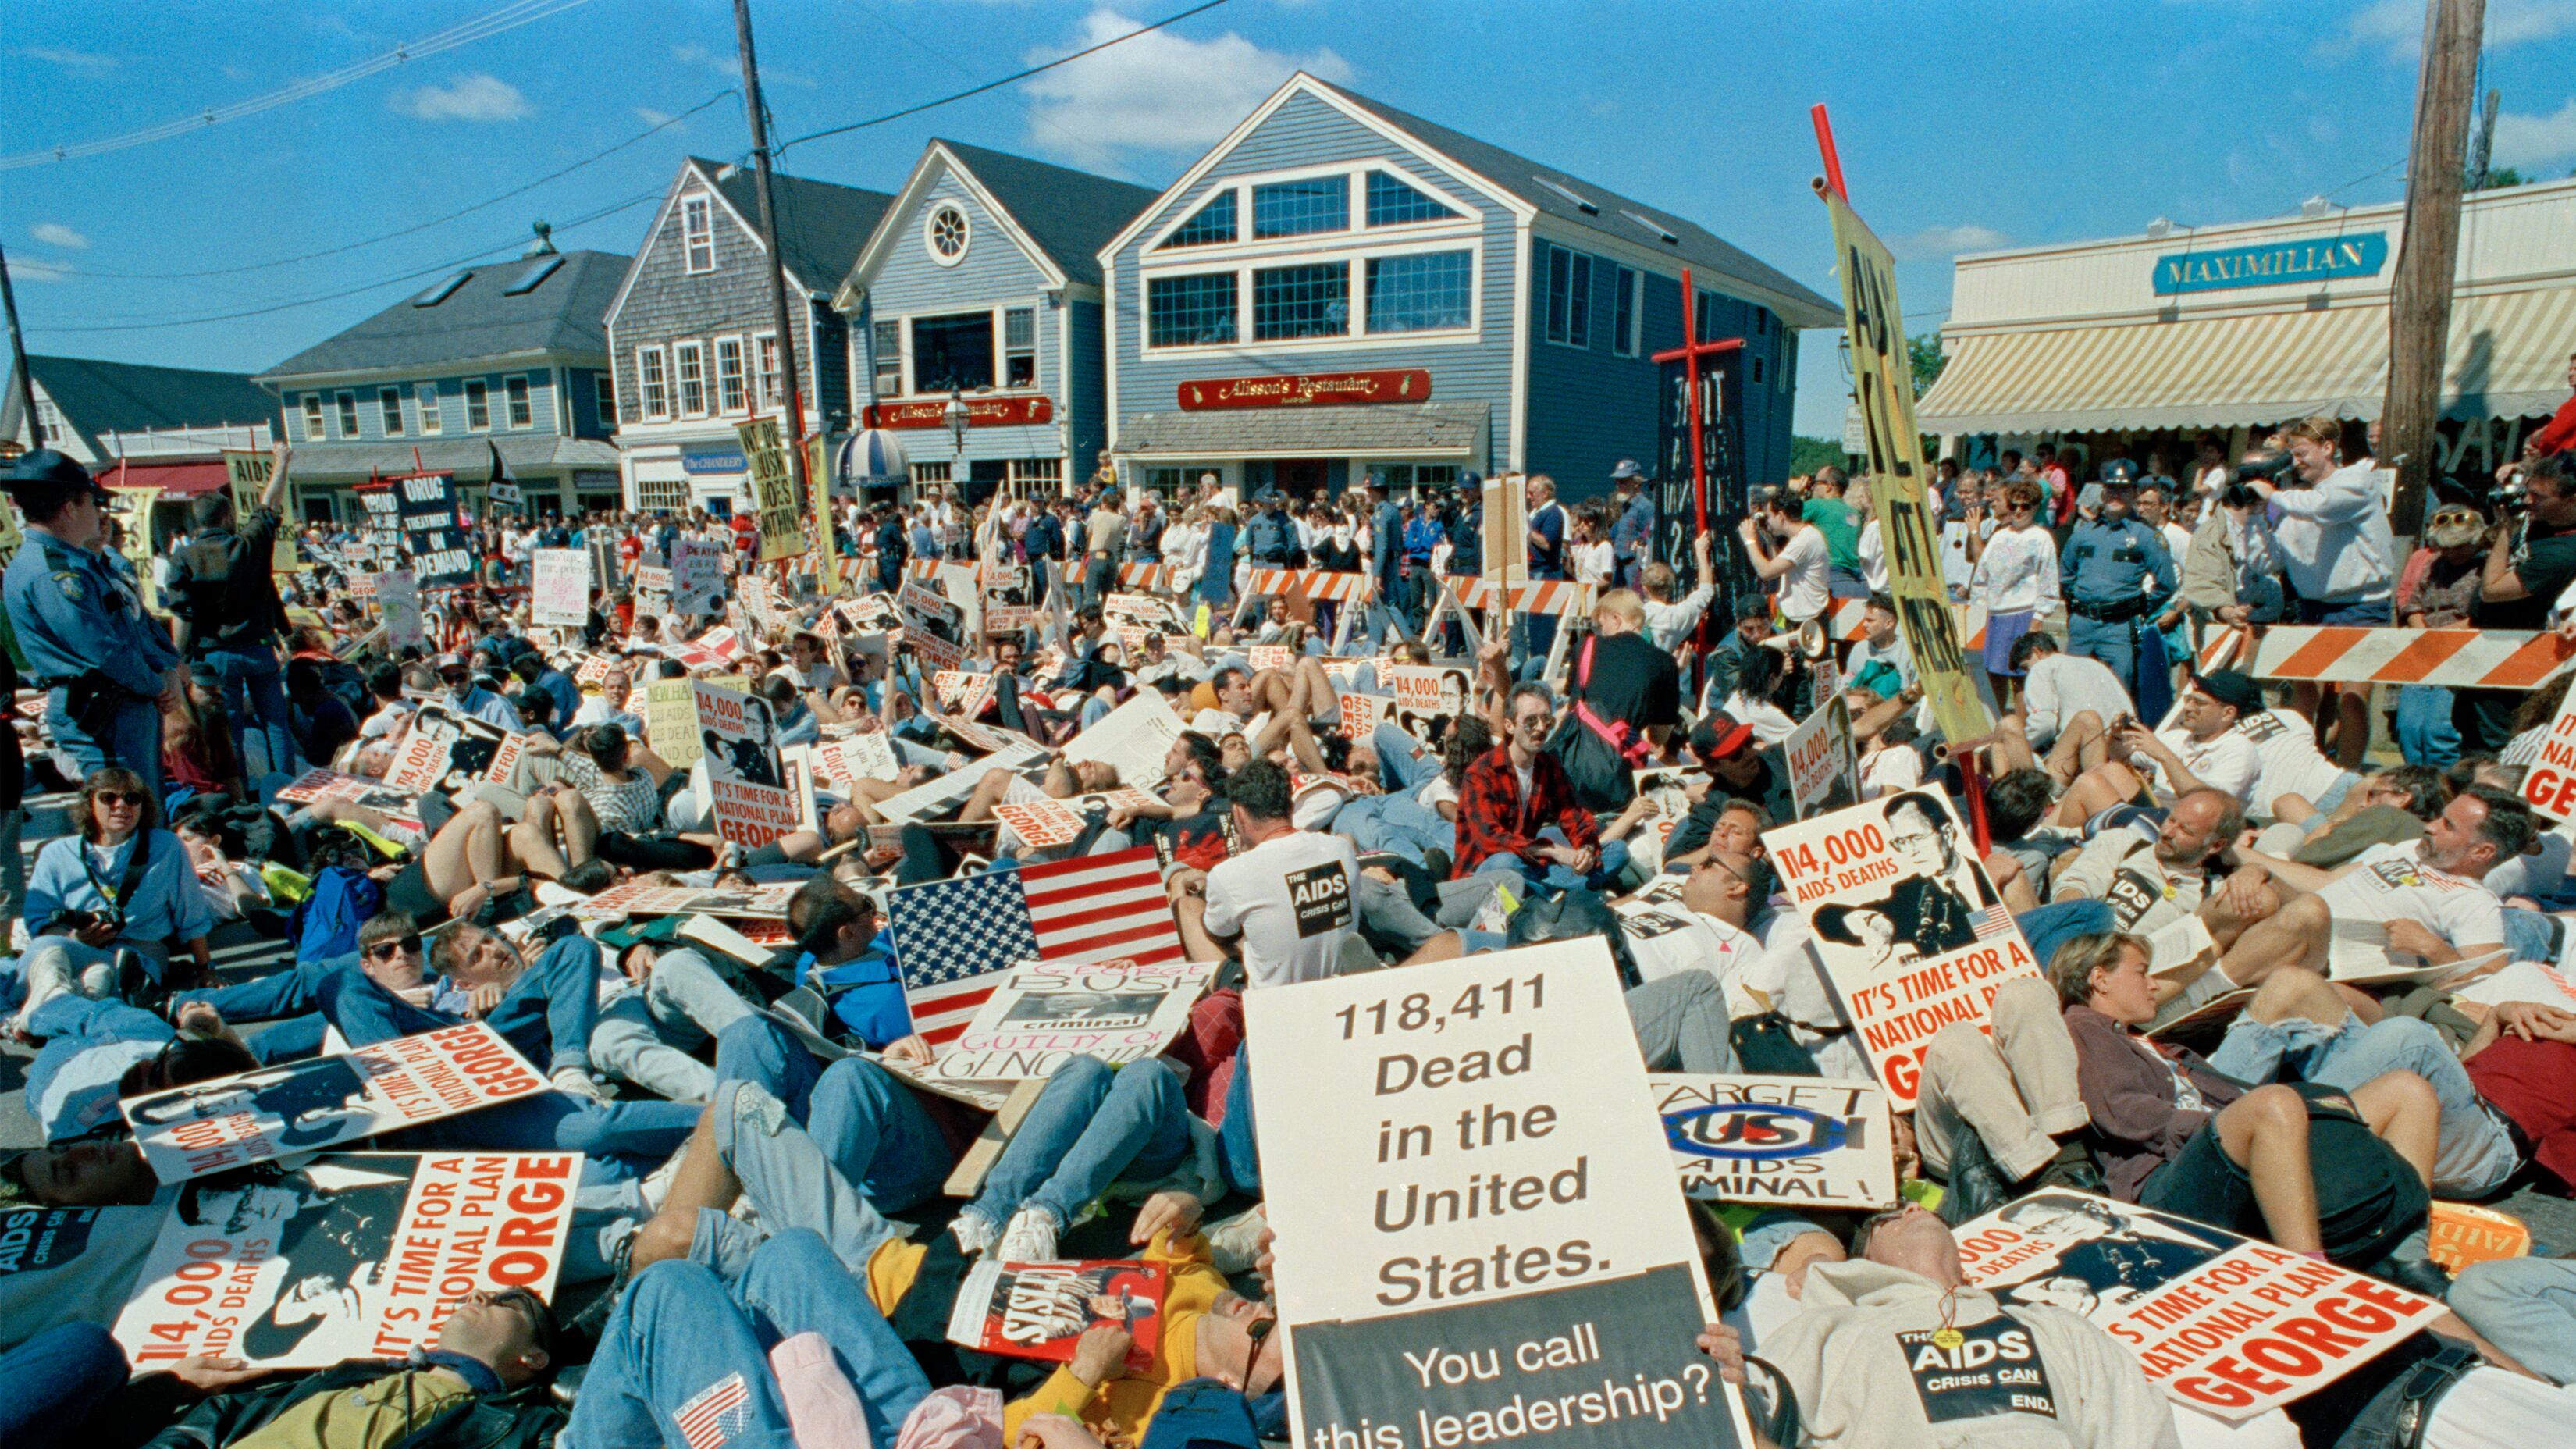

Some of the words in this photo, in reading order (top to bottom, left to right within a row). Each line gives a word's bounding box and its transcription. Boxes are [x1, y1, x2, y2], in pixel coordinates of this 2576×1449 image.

[2169, 241, 2366, 283] MAXIMILIAN
[1220, 378, 1290, 399] Alisson's
[1297, 376, 1379, 397] Restaurant
[891, 404, 942, 422] Alisson's
[699, 456, 744, 468] CHANDLERY
[404, 476, 446, 502] DRUG
[404, 512, 453, 532] TREATMENT
[430, 532, 446, 550] ON
[686, 546, 720, 557] DEATH
[413, 549, 471, 578] DEMAND
[352, 587, 375, 596] GEOR
[1396, 678, 1438, 696] 114,000
[667, 707, 692, 721] AIDS
[1342, 695, 1354, 739] GEO
[1415, 697, 1440, 710] DEATHS
[700, 714, 717, 728] AIDS
[719, 718, 745, 734] DEATHS
[394, 738, 434, 786] 114,000
[427, 744, 448, 774] DEATHS
[501, 745, 518, 767] FOR
[1789, 727, 1828, 780] 114,000
[1810, 757, 1834, 790] DEATHS
[713, 781, 732, 798] IT'S
[734, 785, 760, 802] TIME
[760, 789, 781, 805] FOR
[784, 793, 792, 808] A
[715, 799, 768, 821] NATIONAL
[770, 805, 797, 824] PLAN
[997, 805, 1055, 847] GEORGE
[1024, 803, 1059, 831] NATIONAL
[1777, 823, 1884, 880] 114,000
[1287, 871, 1307, 885] THE
[1294, 874, 1347, 906] AIDS
[1796, 875, 1836, 903] AIDS
[1838, 857, 1899, 891] DEATHS
[2113, 878, 2151, 910] IDS
[1300, 904, 1329, 920] CRISIS
[1332, 898, 1349, 912] CAN
[2115, 915, 2130, 931] ND.
[2119, 902, 2138, 919] CAN
[1008, 974, 1209, 992] BUSH
[1852, 981, 1897, 1020] IT'S
[1898, 961, 1957, 1003] TIME
[1959, 947, 2005, 986] FOR
[2007, 940, 2030, 967] A
[1023, 1015, 1140, 1031] criminal
[1335, 973, 1545, 1041] 118,411
[1863, 992, 1984, 1053] NATIONAL
[352, 1046, 382, 1058] A
[392, 1037, 442, 1063] PLAN
[961, 1034, 1108, 1051] GUILTY
[365, 1057, 403, 1077] FOR
[429, 1025, 540, 1097] GEORGE
[1375, 1031, 1533, 1097] Dead
[375, 1075, 422, 1101] TIME
[419, 1060, 483, 1109] NATIONAL
[393, 1098, 443, 1120] IT'S
[223, 1109, 262, 1143] DEATHS
[1377, 1120, 1432, 1163] in
[1456, 1102, 1557, 1151] the
[171, 1119, 239, 1173] 114,000
[243, 1137, 272, 1161] AIDS
[430, 1156, 466, 1176] A
[1678, 1157, 1826, 1174] AIDS
[461, 1155, 508, 1219] PLAN
[1374, 1155, 1589, 1233] United
[411, 1179, 461, 1230] FOR
[488, 1155, 573, 1292] ORGE
[0, 1210, 39, 1272] AIDS
[33, 1223, 62, 1262] CRISIS
[392, 1234, 441, 1297] TIME
[1375, 1236, 1612, 1308] States.
[1985, 1238, 2055, 1279] DEATHS
[135, 1237, 233, 1365] 114,000
[197, 1309, 241, 1360] AIDS
[220, 1237, 270, 1308] DEATHS
[2129, 1285, 2210, 1336] TIME
[2210, 1258, 2267, 1300] FOR
[2264, 1248, 2296, 1273] A
[2261, 1261, 2348, 1312] PLAN
[372, 1305, 422, 1359] IT'S
[1902, 1330, 1937, 1344] THE
[2174, 1280, 2430, 1408] GEORGE
[1404, 1346, 1500, 1389] You
[1516, 1322, 1601, 1372] call
[1912, 1331, 2031, 1372] AIDS
[1926, 1372, 1991, 1393] CRISIS
[1999, 1367, 2041, 1385] CAN
[1314, 1419, 1402, 1449] this
[1419, 1362, 1711, 1449] leadership?
[2010, 1394, 2055, 1415] END.
